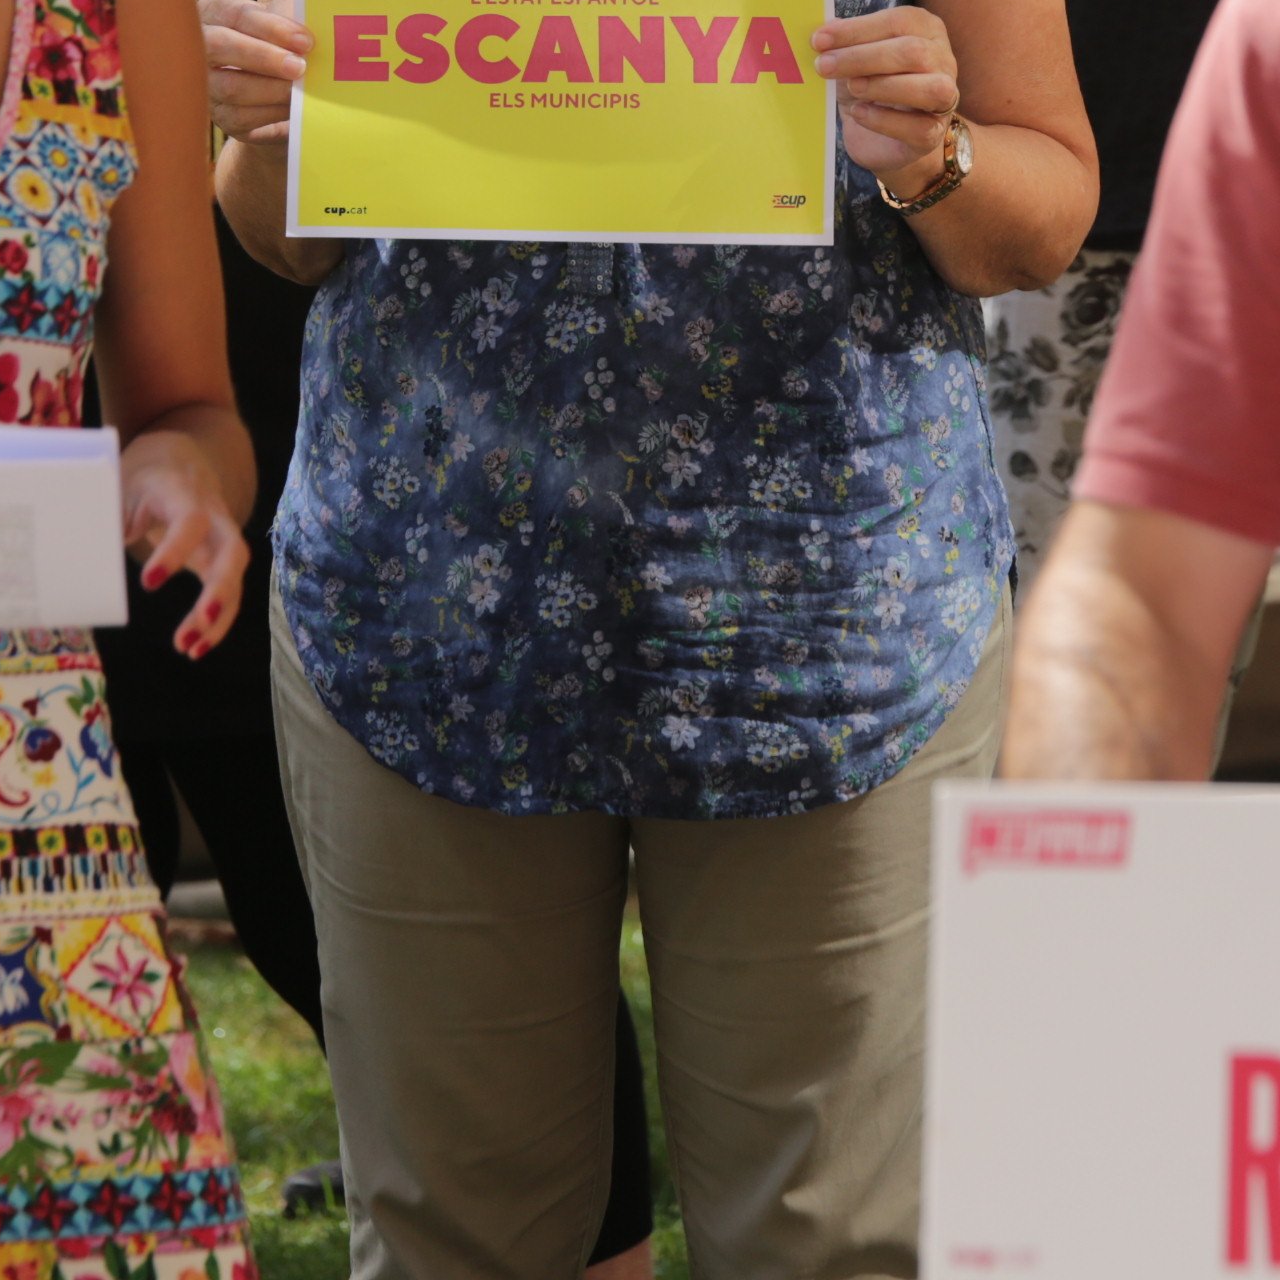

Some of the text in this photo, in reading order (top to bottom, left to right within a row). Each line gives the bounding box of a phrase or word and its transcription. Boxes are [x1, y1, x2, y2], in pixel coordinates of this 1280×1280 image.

[333, 13, 805, 85] ESCANYA
[489, 92, 641, 110] ELS MUNICIPIS
[324, 206, 368, 217] cup.cat
